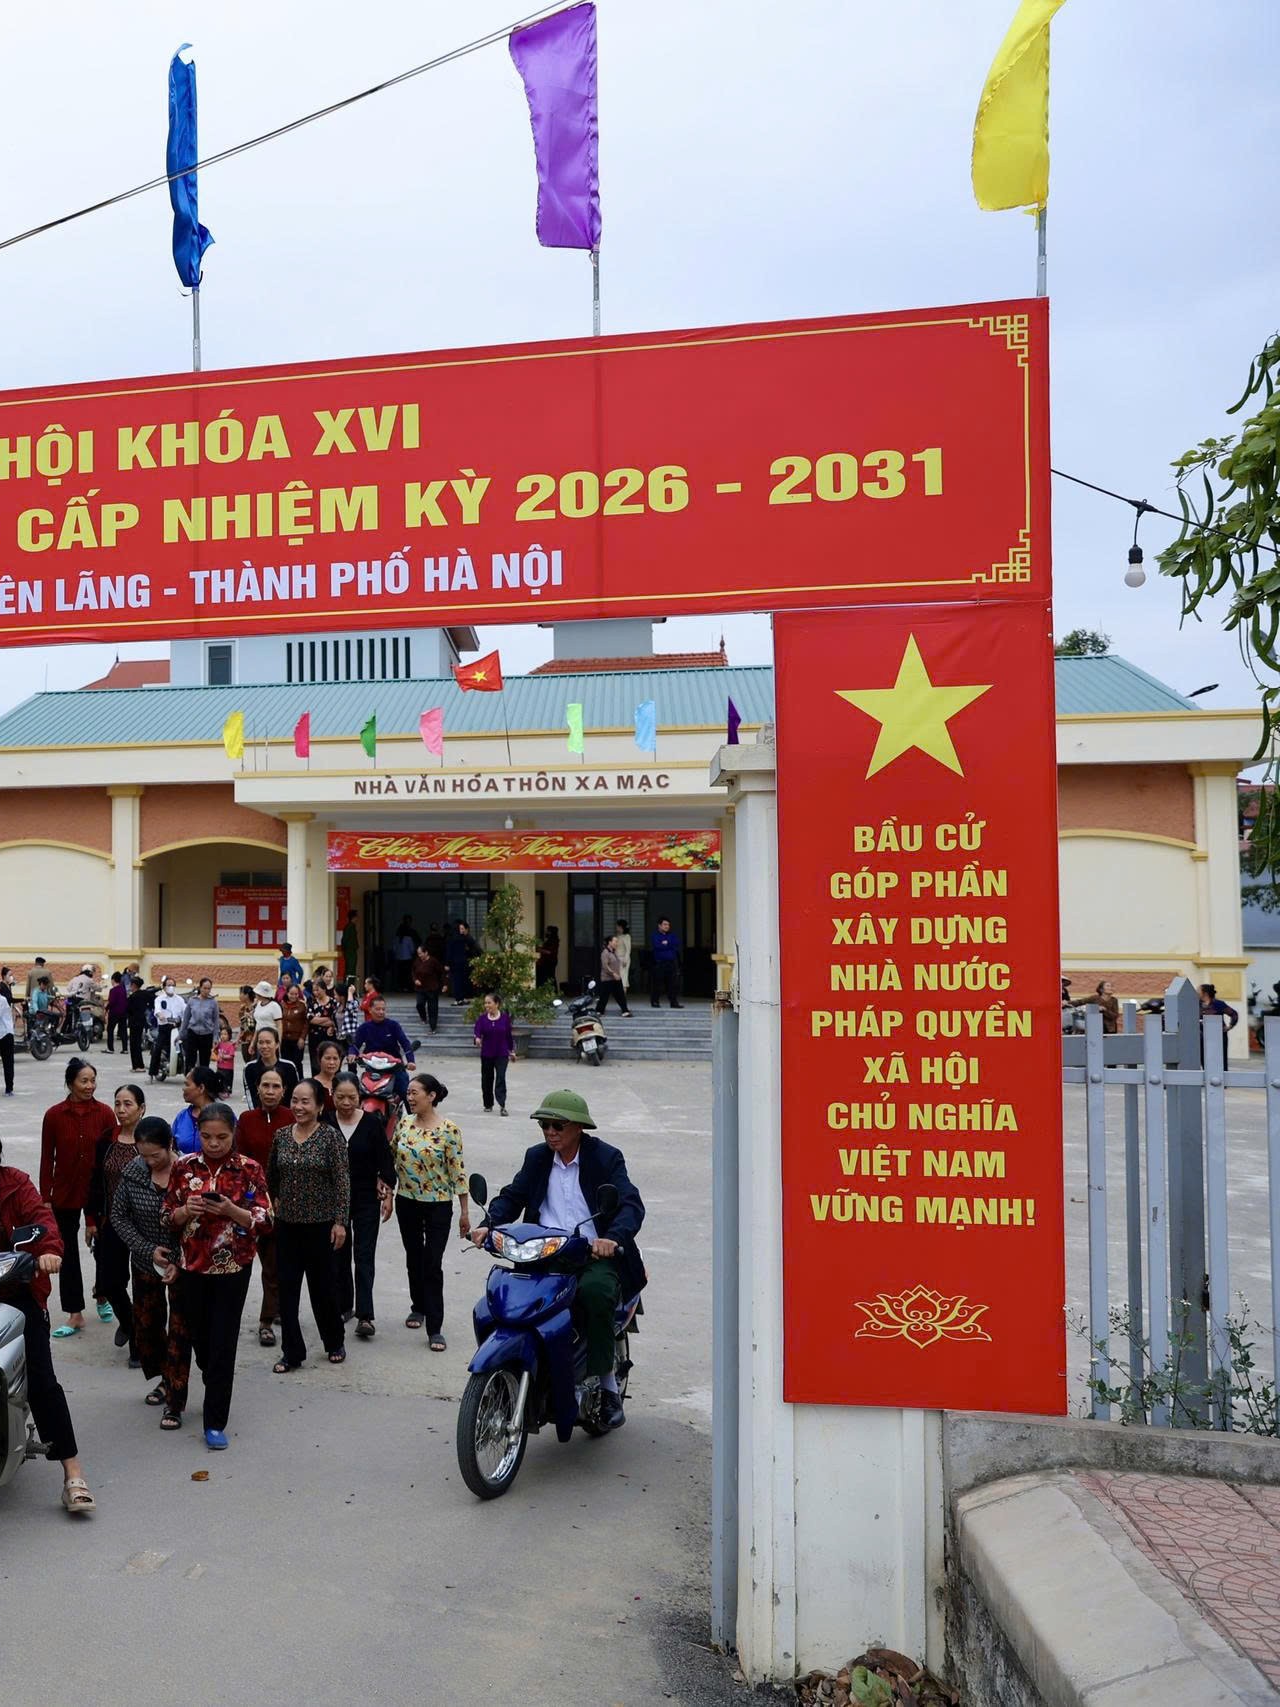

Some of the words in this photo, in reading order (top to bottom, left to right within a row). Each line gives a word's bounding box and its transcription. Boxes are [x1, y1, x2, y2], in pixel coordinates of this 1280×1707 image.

[118, 409, 291, 470] KHÓA
[313, 404, 419, 455] XVI
[18, 489, 139, 552] CẤP
[164, 481, 378, 545] NHIỆM
[405, 469, 491, 528] KỲ
[516, 465, 689, 521] 2026
[716, 483, 741, 493] -
[769, 448, 942, 504] 2031
[56, 571, 150, 611] LÃNG
[189, 561, 316, 604] THÀNH
[331, 546, 411, 597] PHỐ
[424, 548, 478, 592] HÀ
[492, 544, 562, 595] NỘI
[355, 774, 398, 795] NHÀ
[405, 773, 445, 793] VĂN
[452, 772, 498, 793] HÓA
[503, 771, 566, 792] THÔN
[575, 776, 608, 791] XA
[617, 774, 669, 792] MẠC
[854, 816, 922, 852] BẦU
[936, 812, 986, 850] CỬ
[831, 867, 898, 899] GÓP
[912, 861, 1007, 897] PHẦN
[832, 913, 898, 944] XÂY
[911, 915, 1006, 949] DỰNG
[831, 959, 902, 990] NHÀ
[915, 956, 1010, 990] NƯỚC
[812, 1005, 903, 1036] PHÁP
[917, 1001, 1031, 1040] QUYỀN
[863, 1052, 909, 1083] XÃ
[922, 1052, 978, 1089] HỘI
[828, 1092, 895, 1129] CHỦ
[909, 1099, 1018, 1131] NGHĨA
[839, 1144, 911, 1181] VIỆT
[924, 1151, 1005, 1177] NAM
[810, 1189, 902, 1222] VỮNG
[916, 1197, 1034, 1230] MẠNH!
